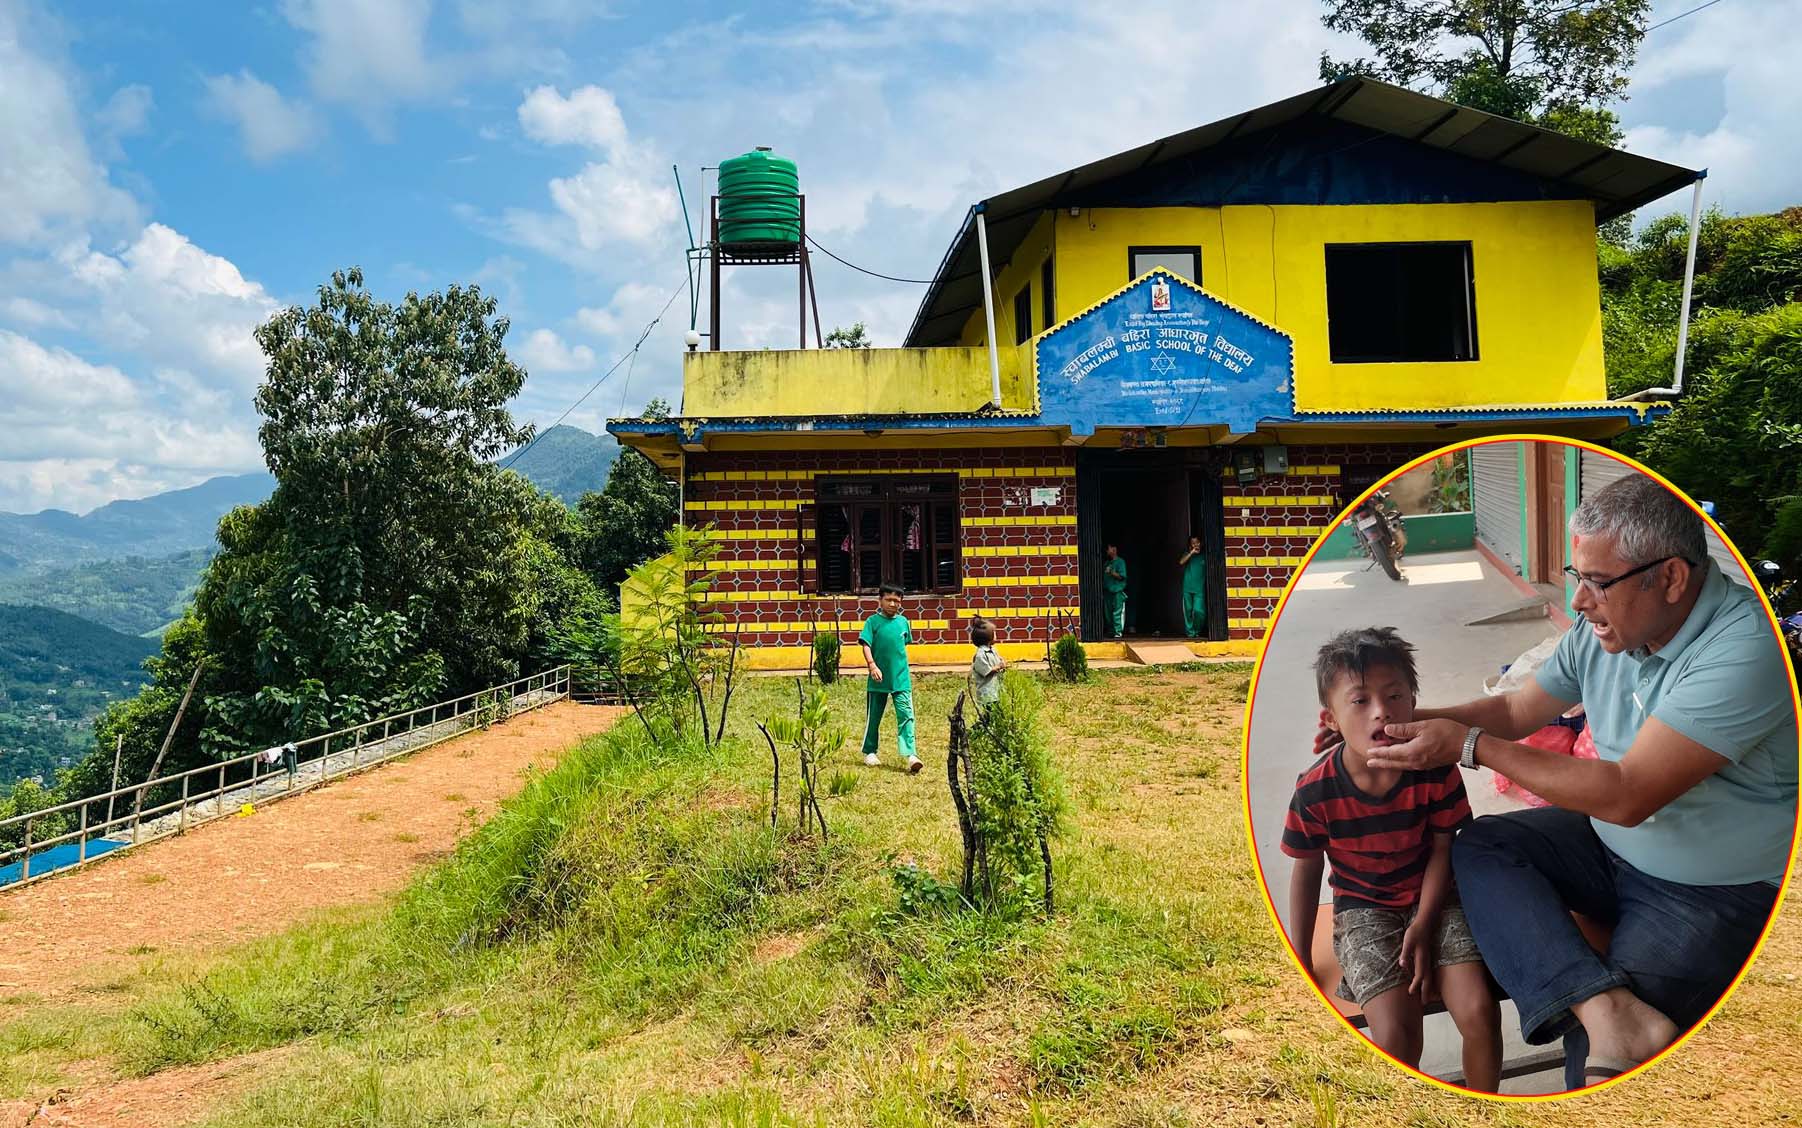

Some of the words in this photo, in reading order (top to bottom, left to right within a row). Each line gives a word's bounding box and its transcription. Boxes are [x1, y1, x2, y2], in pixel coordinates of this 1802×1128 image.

[1071, 349, 1119, 385] SWABALAMBI
[1125, 340, 1151, 353] BASIC
[1156, 339, 1192, 352] SCHOOL
[1194, 344, 1207, 355] OF
[1208, 349, 1223, 363] THE
[1223, 358, 1244, 375] DEAF
